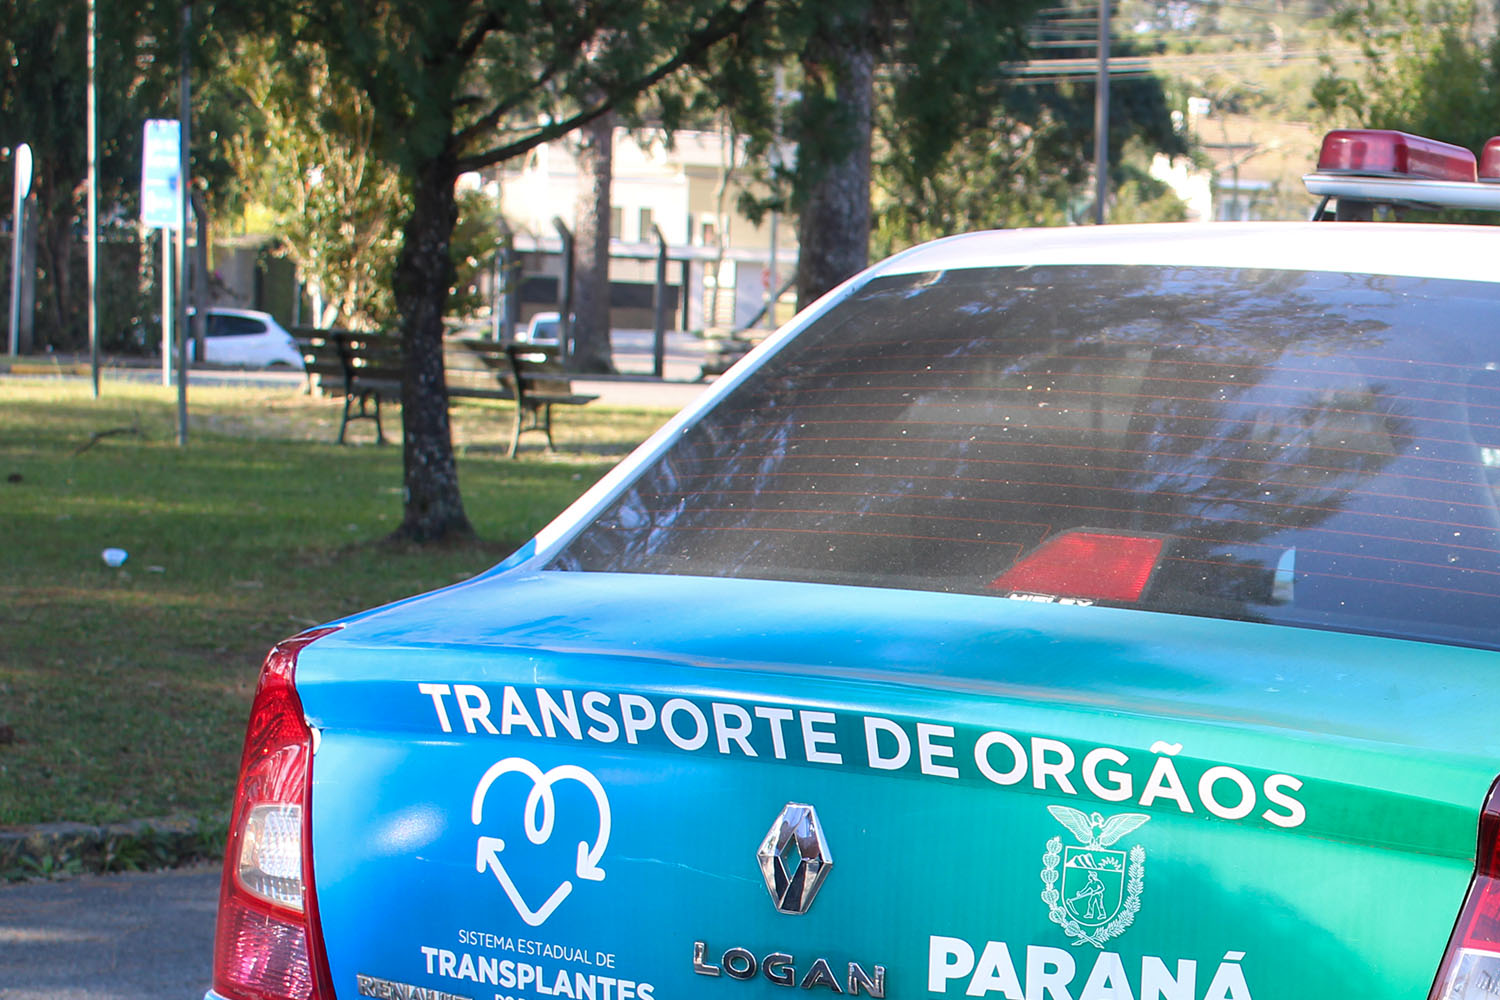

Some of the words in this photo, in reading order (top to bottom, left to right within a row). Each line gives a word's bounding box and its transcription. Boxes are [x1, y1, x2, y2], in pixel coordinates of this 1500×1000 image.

[418, 682, 843, 765] TRANSPORTE
[863, 716, 960, 779] DE
[974, 739, 1307, 828] ORGÃOS
[458, 929, 515, 953] SISTEMA
[517, 940, 592, 965] ESTADUAL
[596, 951, 615, 969] DE
[693, 941, 886, 999] LOGAN
